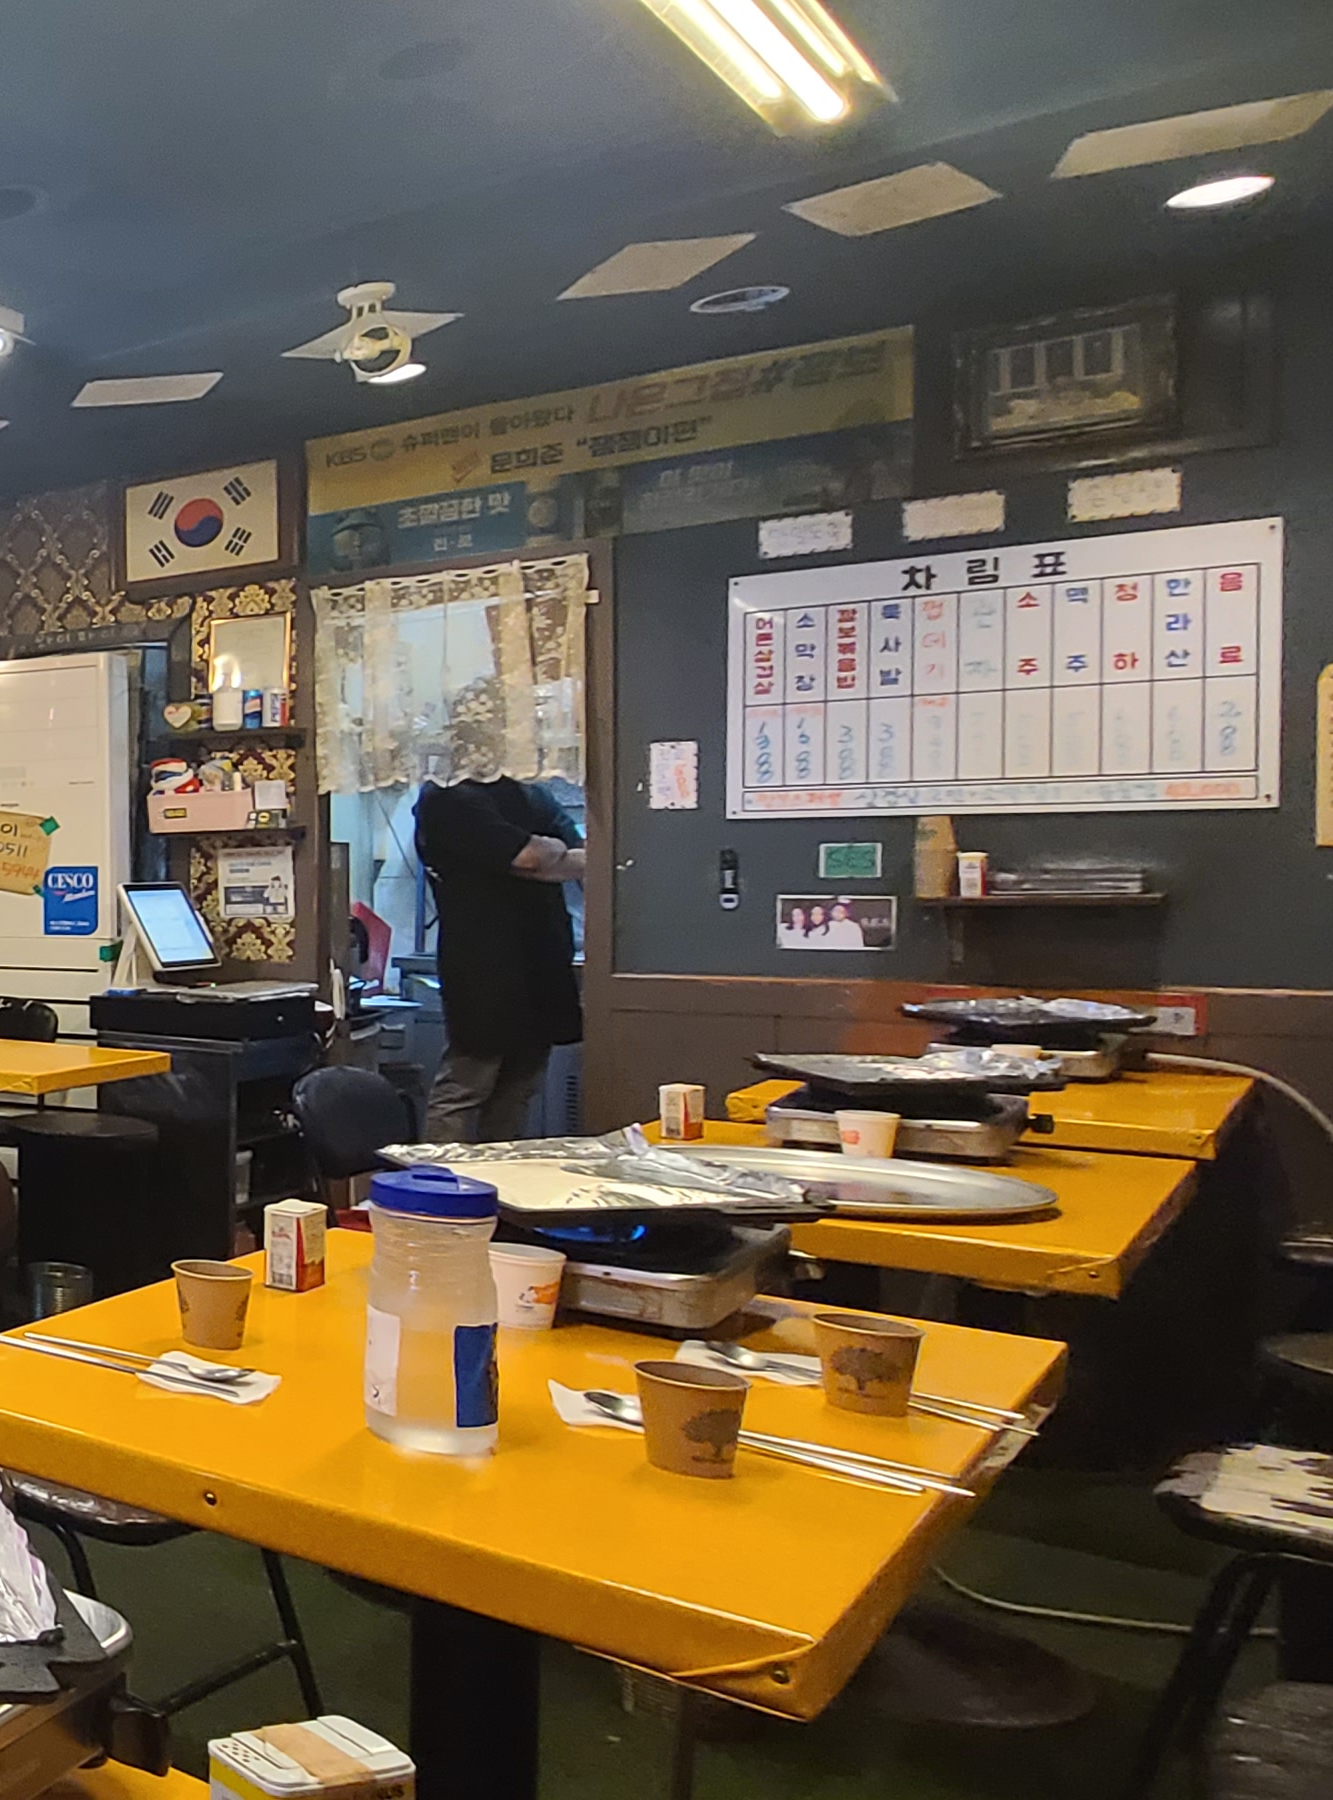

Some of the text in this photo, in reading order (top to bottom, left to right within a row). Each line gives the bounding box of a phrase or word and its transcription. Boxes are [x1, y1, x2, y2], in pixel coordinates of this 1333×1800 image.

[401, 422, 481, 453] 슈퍼맨이
[490, 442, 565, 474] 문희준
[901, 550, 1067, 592] 차림표
[47, 872, 94, 889] CESCO
